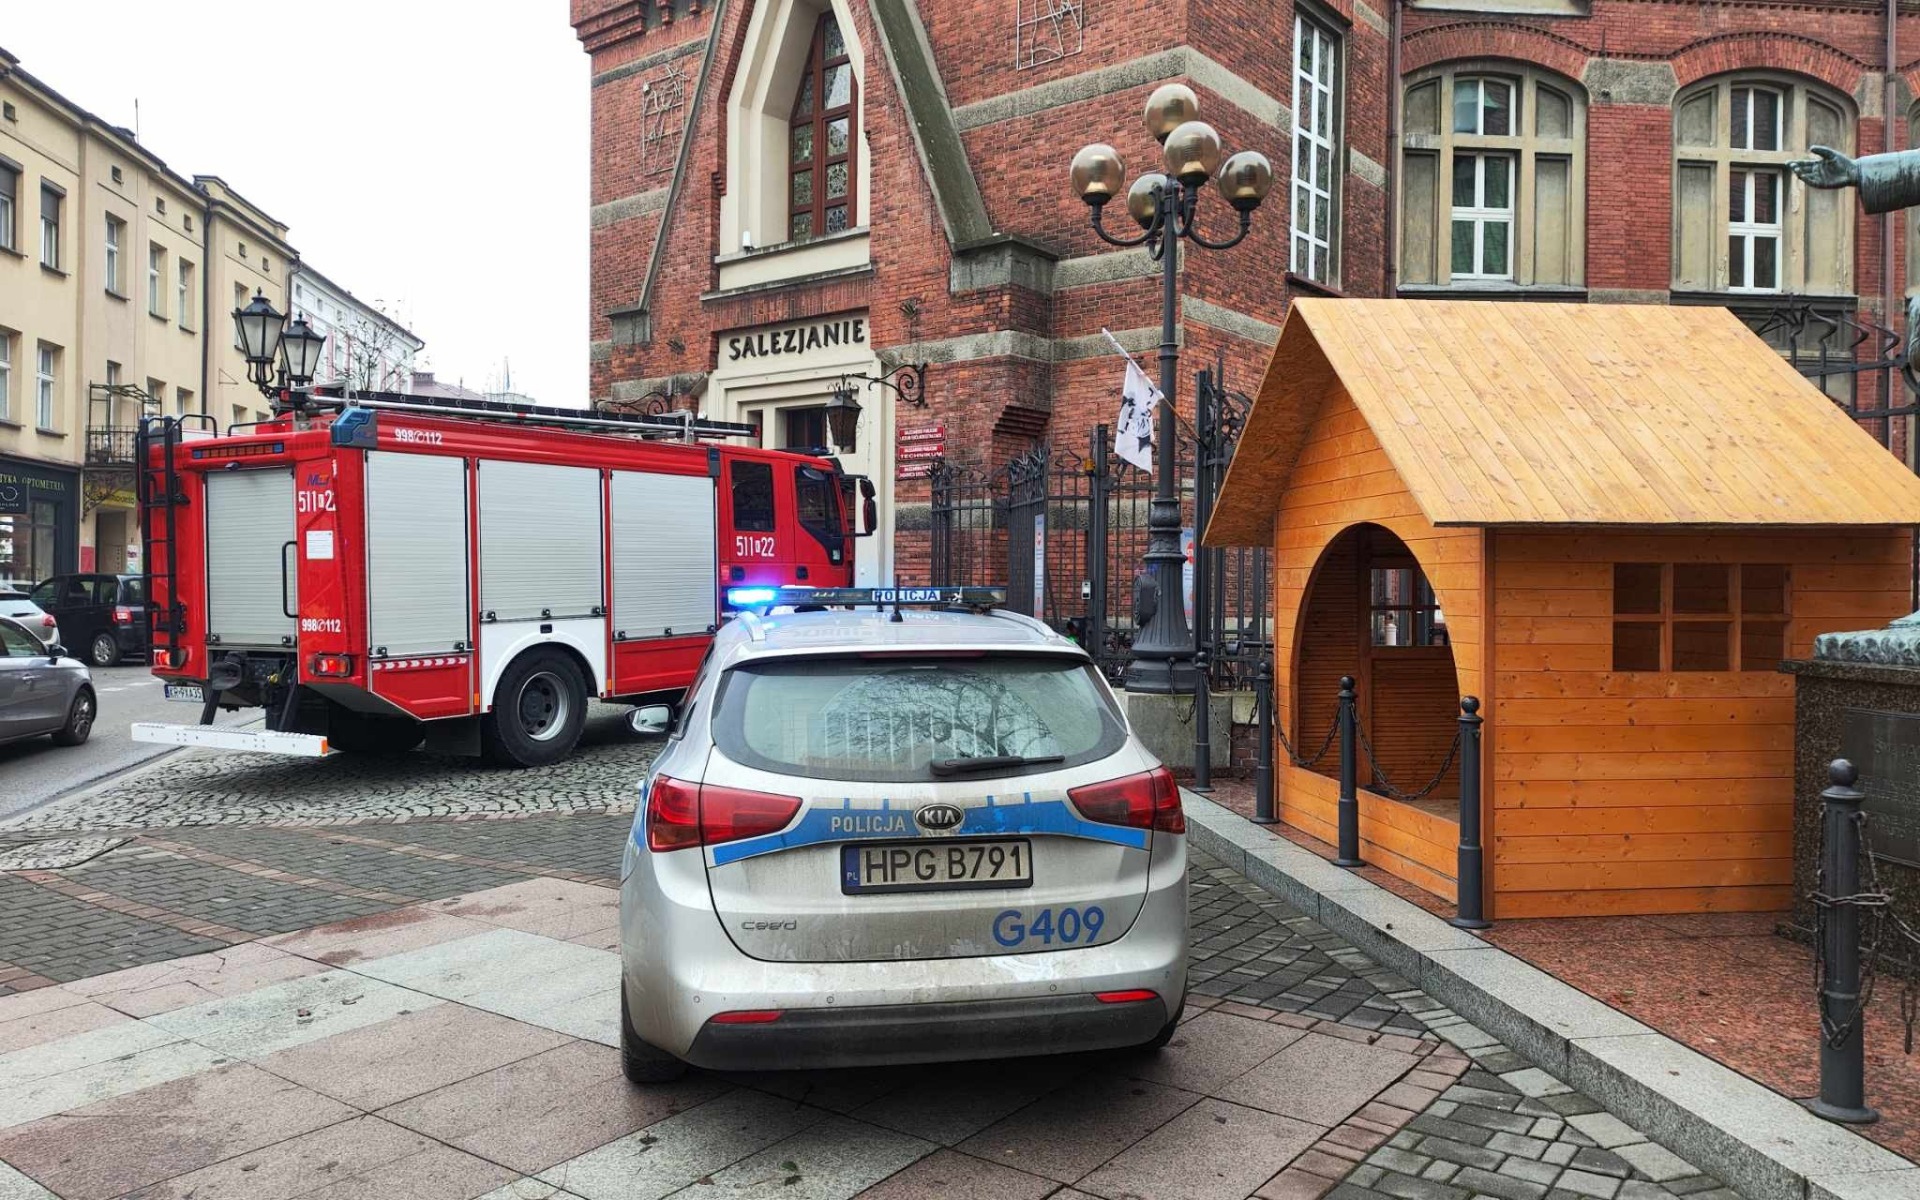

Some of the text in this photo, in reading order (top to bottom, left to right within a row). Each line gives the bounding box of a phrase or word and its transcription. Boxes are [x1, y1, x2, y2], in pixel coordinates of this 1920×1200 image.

[729, 319, 865, 360] SALEZJANIE
[394, 428, 442, 445] 998 112
[22, 476, 65, 491] OPTOMETRIA
[301, 618, 341, 633] 998 112
[831, 815, 906, 833] POLICJA
[924, 809, 956, 825] KIA
[846, 845, 1021, 884] PL HPG B791
[992, 906, 1105, 947] G409
